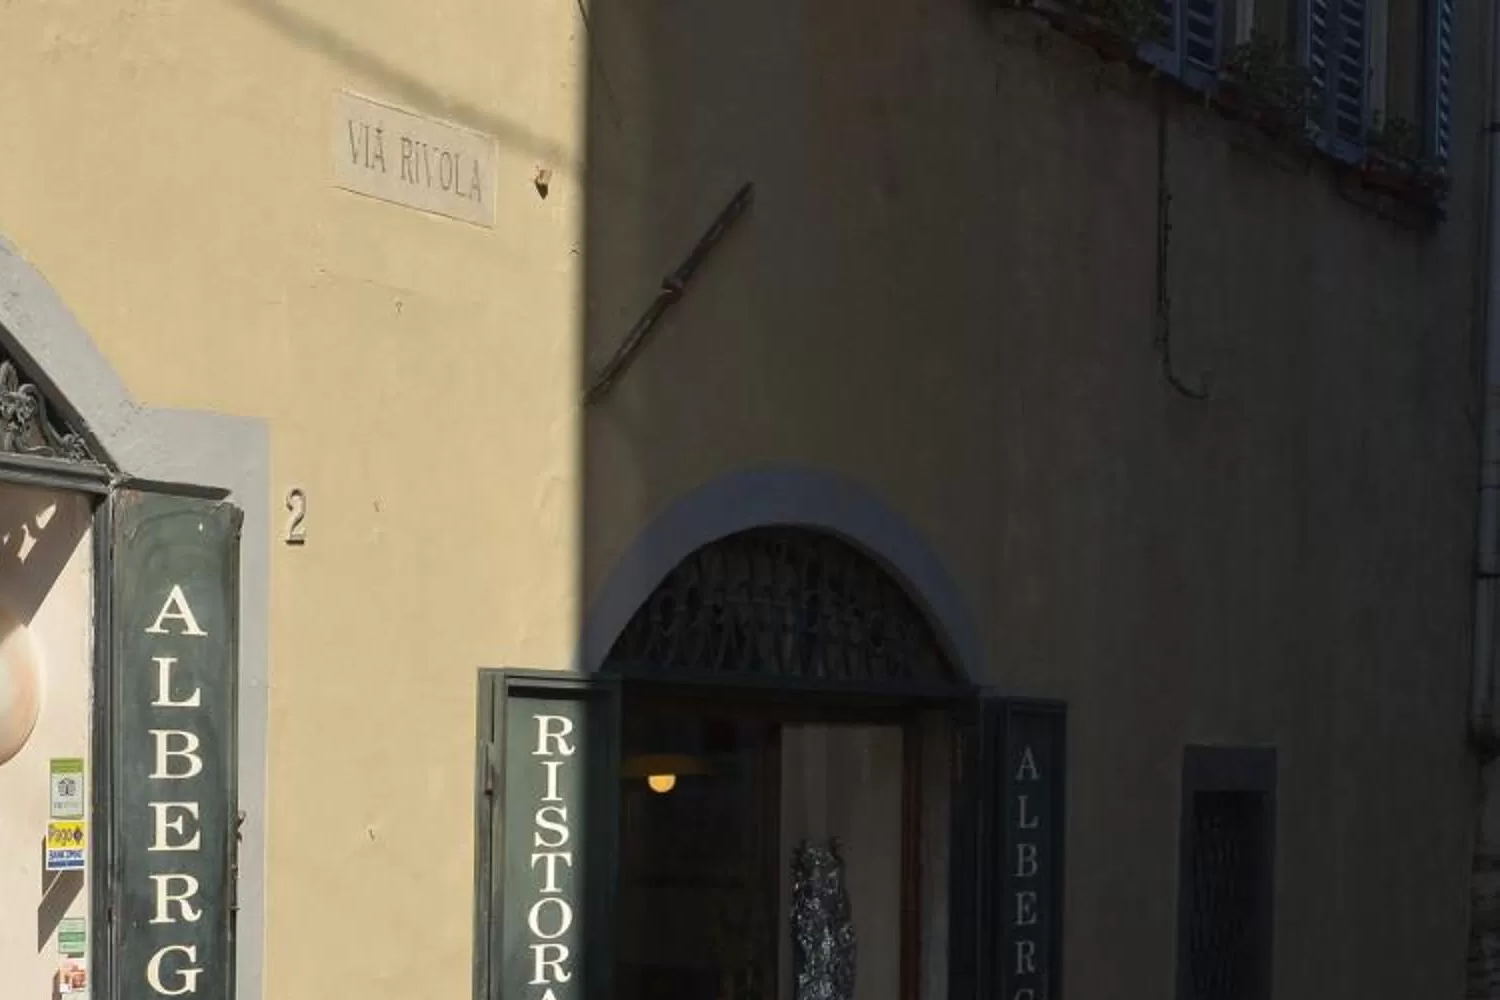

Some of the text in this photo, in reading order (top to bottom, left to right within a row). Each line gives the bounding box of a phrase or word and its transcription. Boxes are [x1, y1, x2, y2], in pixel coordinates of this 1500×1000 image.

[347, 119, 482, 203] VIA RIVOLA
[285, 488, 306, 546] 2
